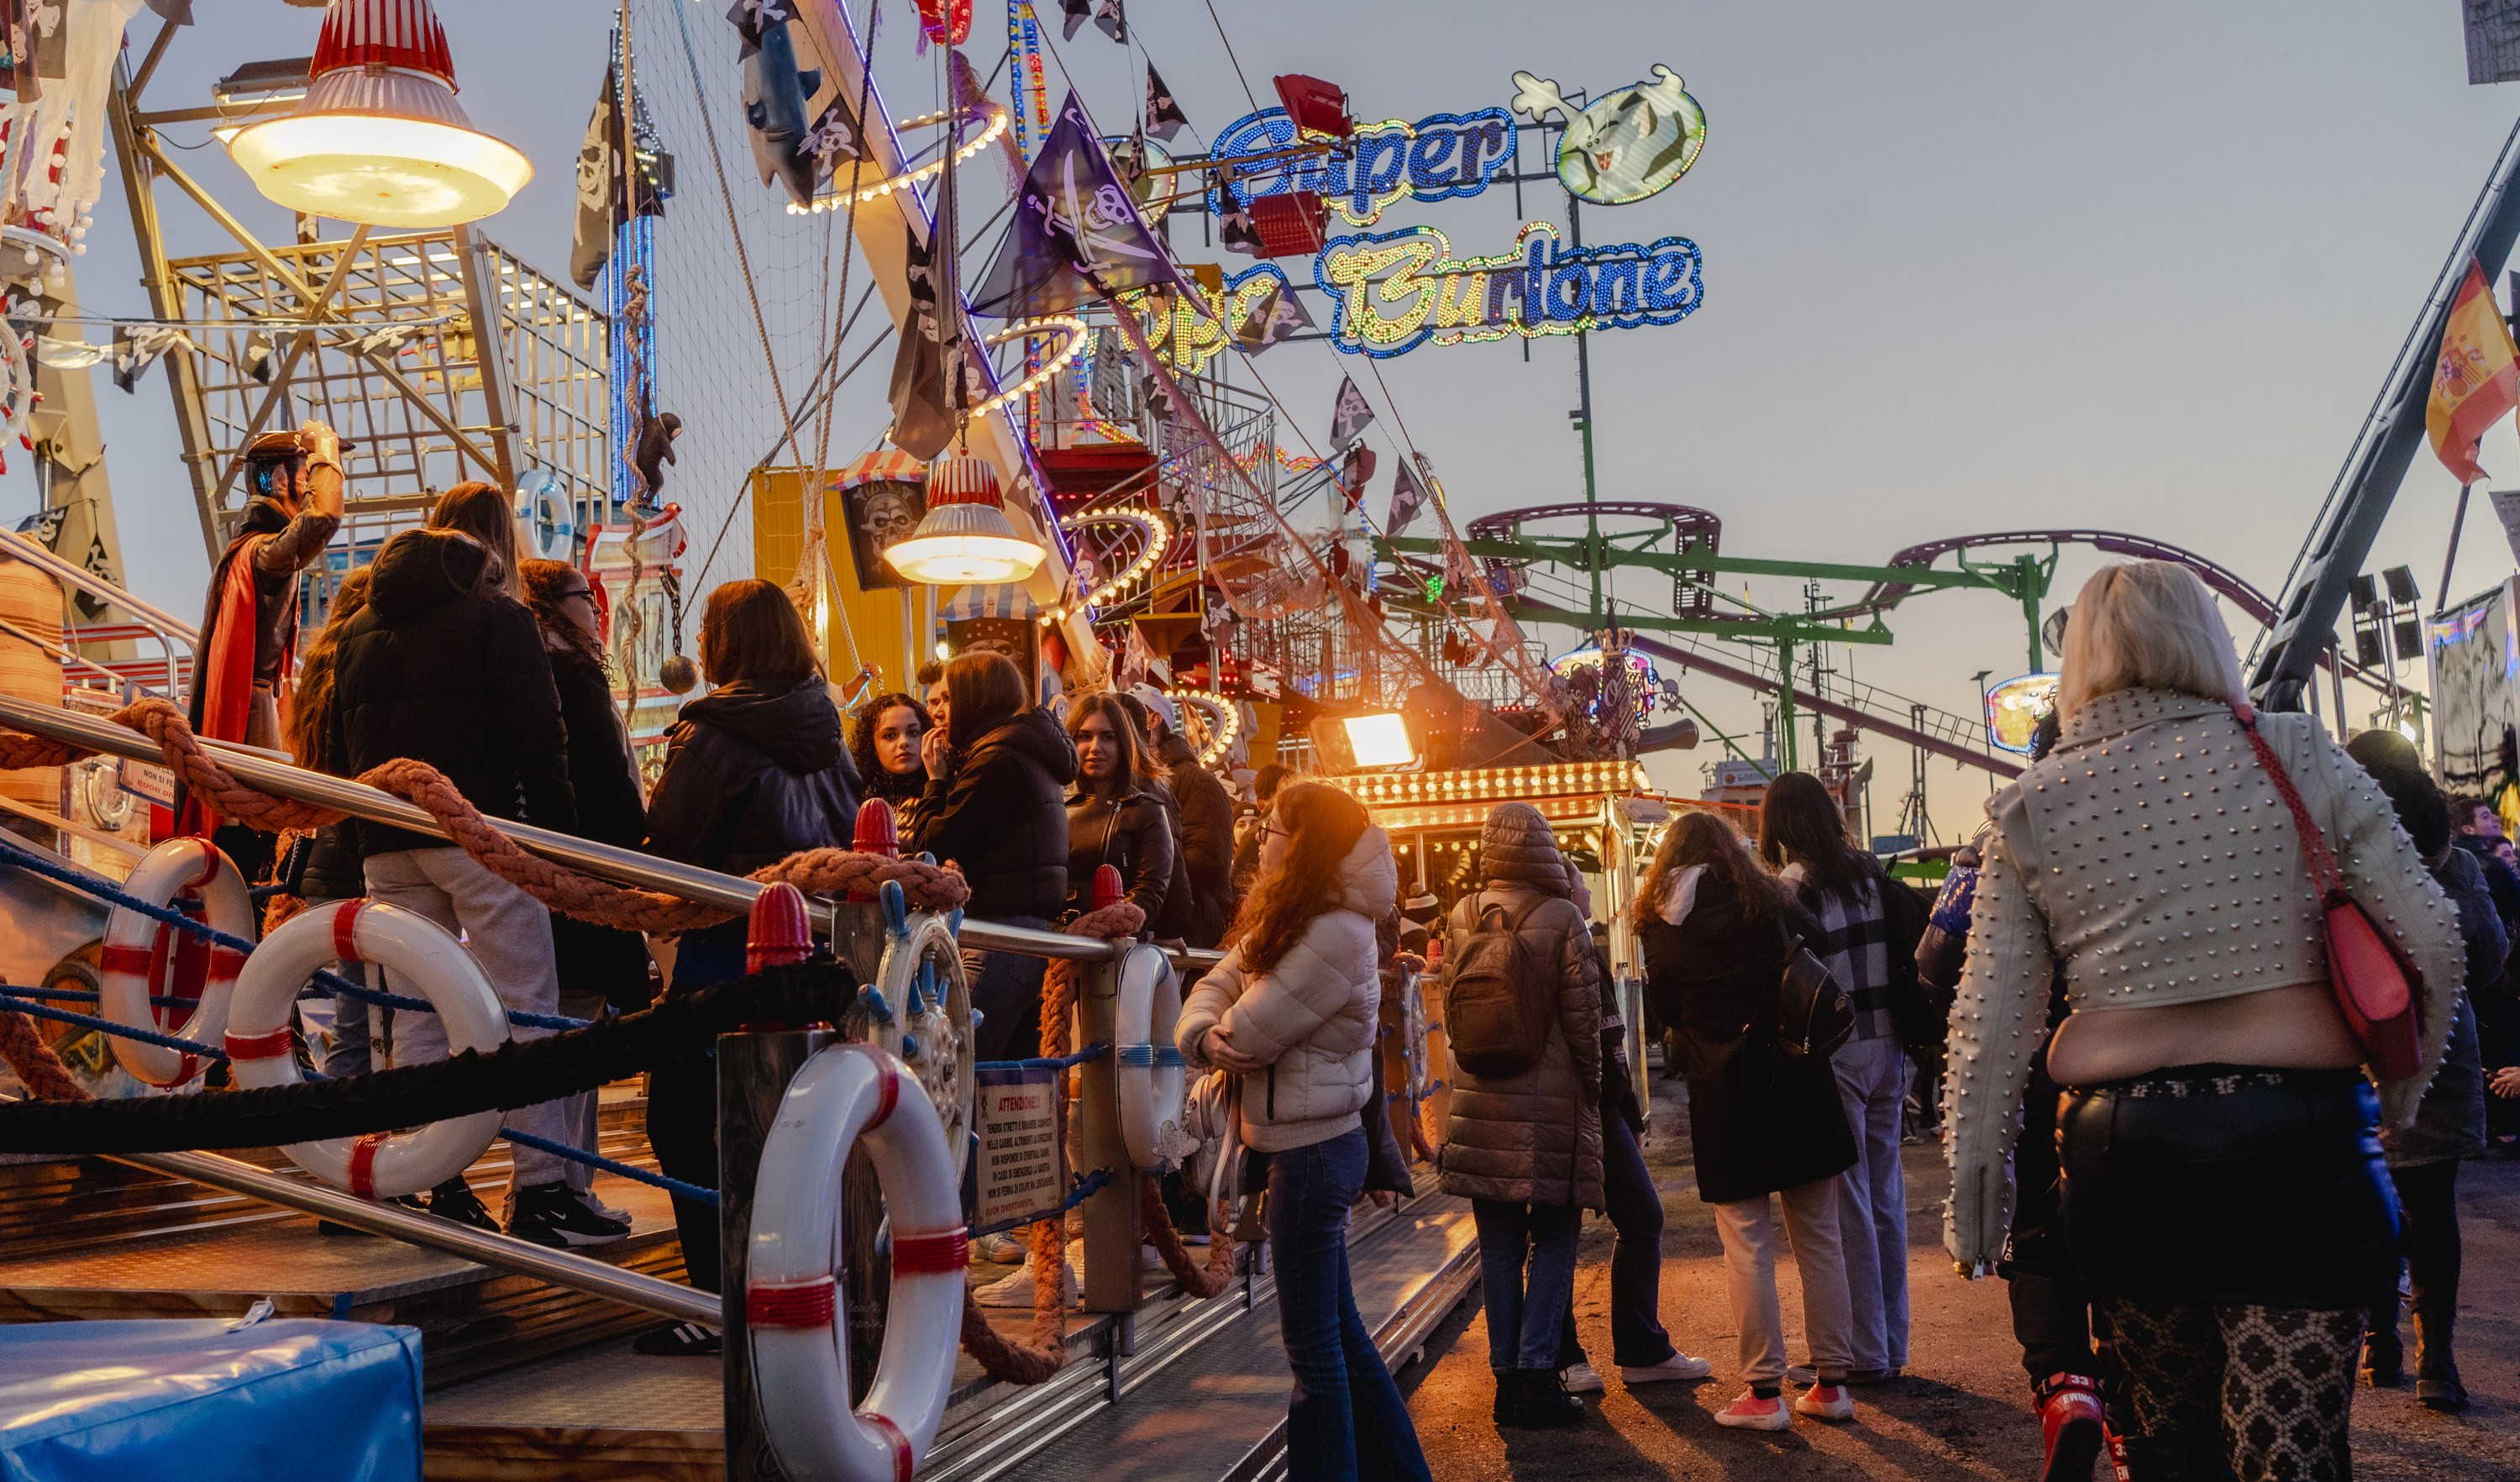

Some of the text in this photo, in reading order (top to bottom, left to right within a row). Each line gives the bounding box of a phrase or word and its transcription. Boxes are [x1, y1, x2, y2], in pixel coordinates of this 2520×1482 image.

[1223, 119, 1502, 214] Super
[1330, 237, 1690, 344] Burlone
[143, 769, 157, 780] NON
[159, 775, 165, 784] SI
[136, 779, 160, 794] BUON
[986, 1122, 1002, 1134] TENERSI
[987, 1138, 998, 1150] NELLE
[1033, 1134, 1037, 1143] LA
[991, 1154, 1000, 1166] NON
[1000, 1153, 1019, 1164] RISPONDE
[1019, 1152, 1023, 1162] DI
[993, 1171, 997, 1182] IN
[998, 1169, 1008, 1180] CASO
[1009, 1169, 1013, 1179] DI
[1033, 1164, 1037, 1175] LA
[988, 1189, 996, 1199] NON
[997, 1188, 1000, 1196] SI
[1001, 1185, 1014, 1196] FERMA
[1015, 1184, 1018, 1194] DI
[1019, 1181, 1030, 1193] COLPO
[1031, 1180, 1035, 1190] MA
[985, 1206, 1000, 1217] BUON
[2070, 1374, 2089, 1386] 33
